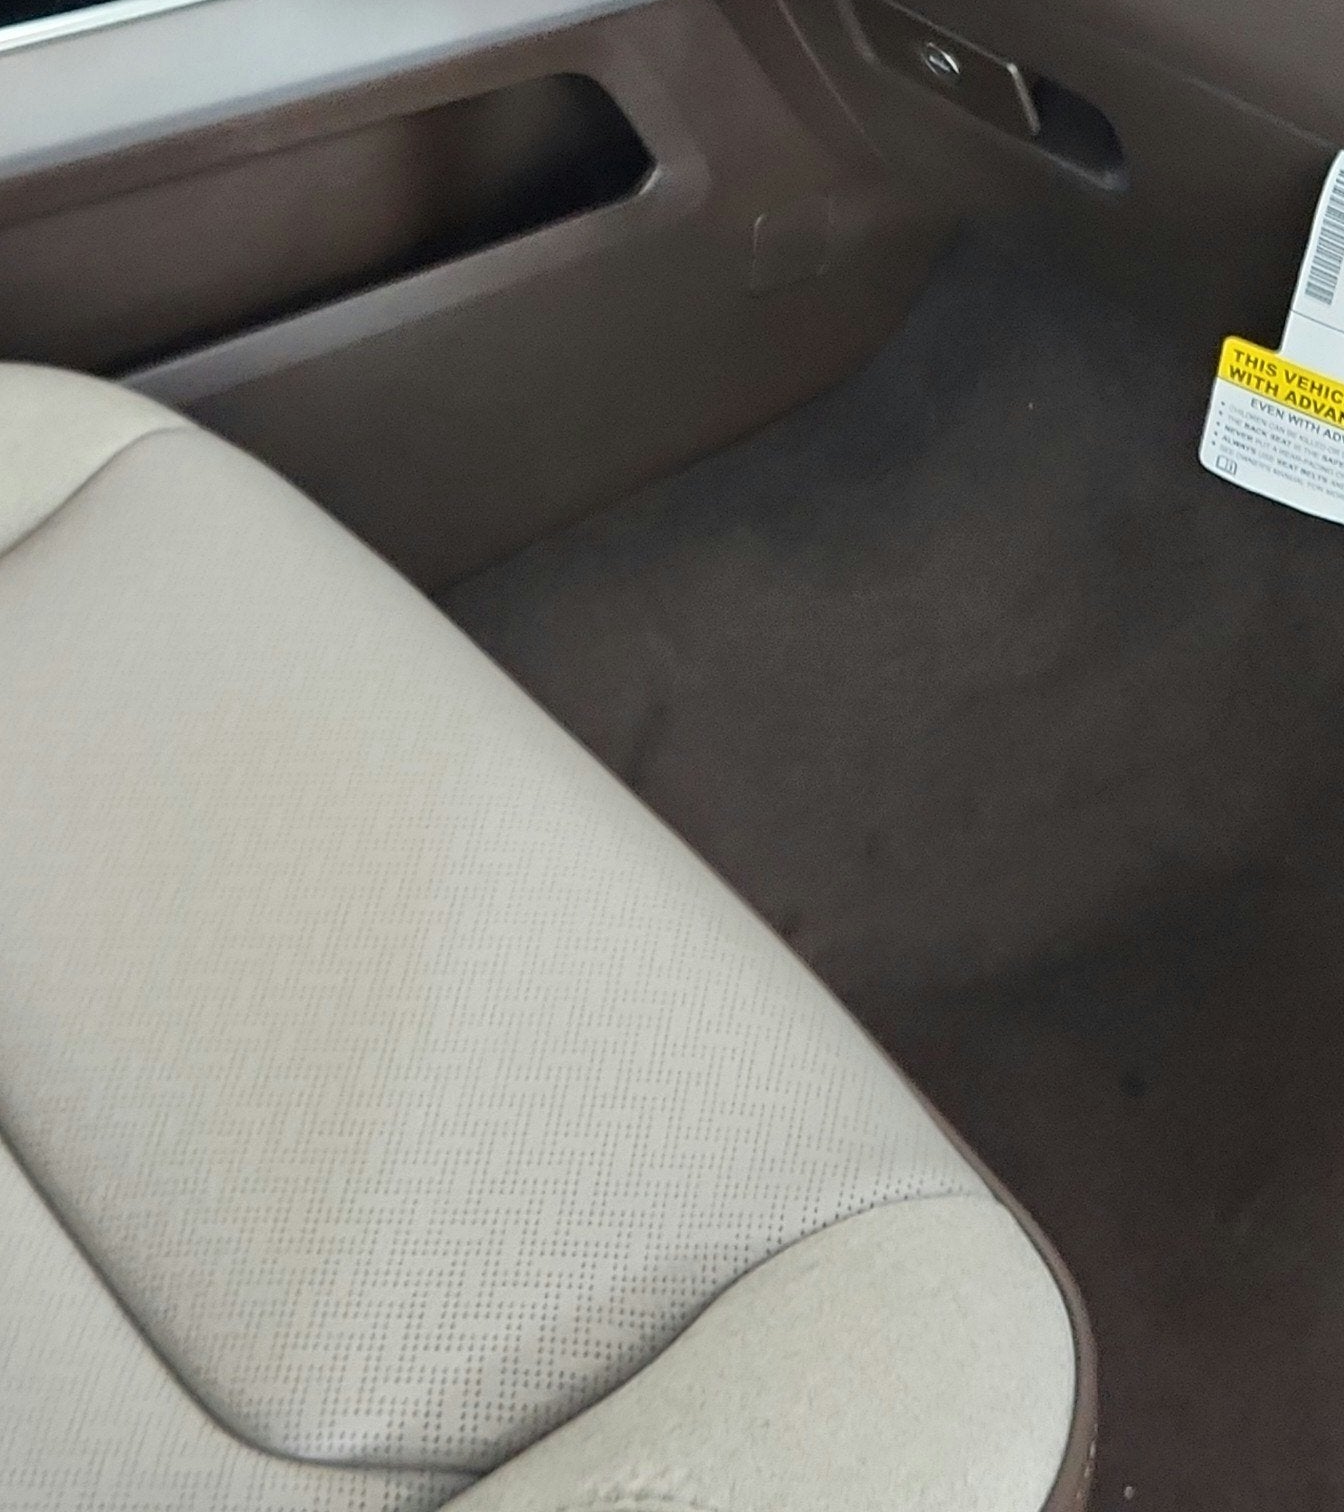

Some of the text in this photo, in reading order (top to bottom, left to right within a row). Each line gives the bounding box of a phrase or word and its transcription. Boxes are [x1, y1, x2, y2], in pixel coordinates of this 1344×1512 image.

[1231, 350, 1278, 376] THIS
[1227, 366, 1278, 395] WITH
[1250, 398, 1283, 417] EVEN
[1287, 414, 1320, 433] WITH
